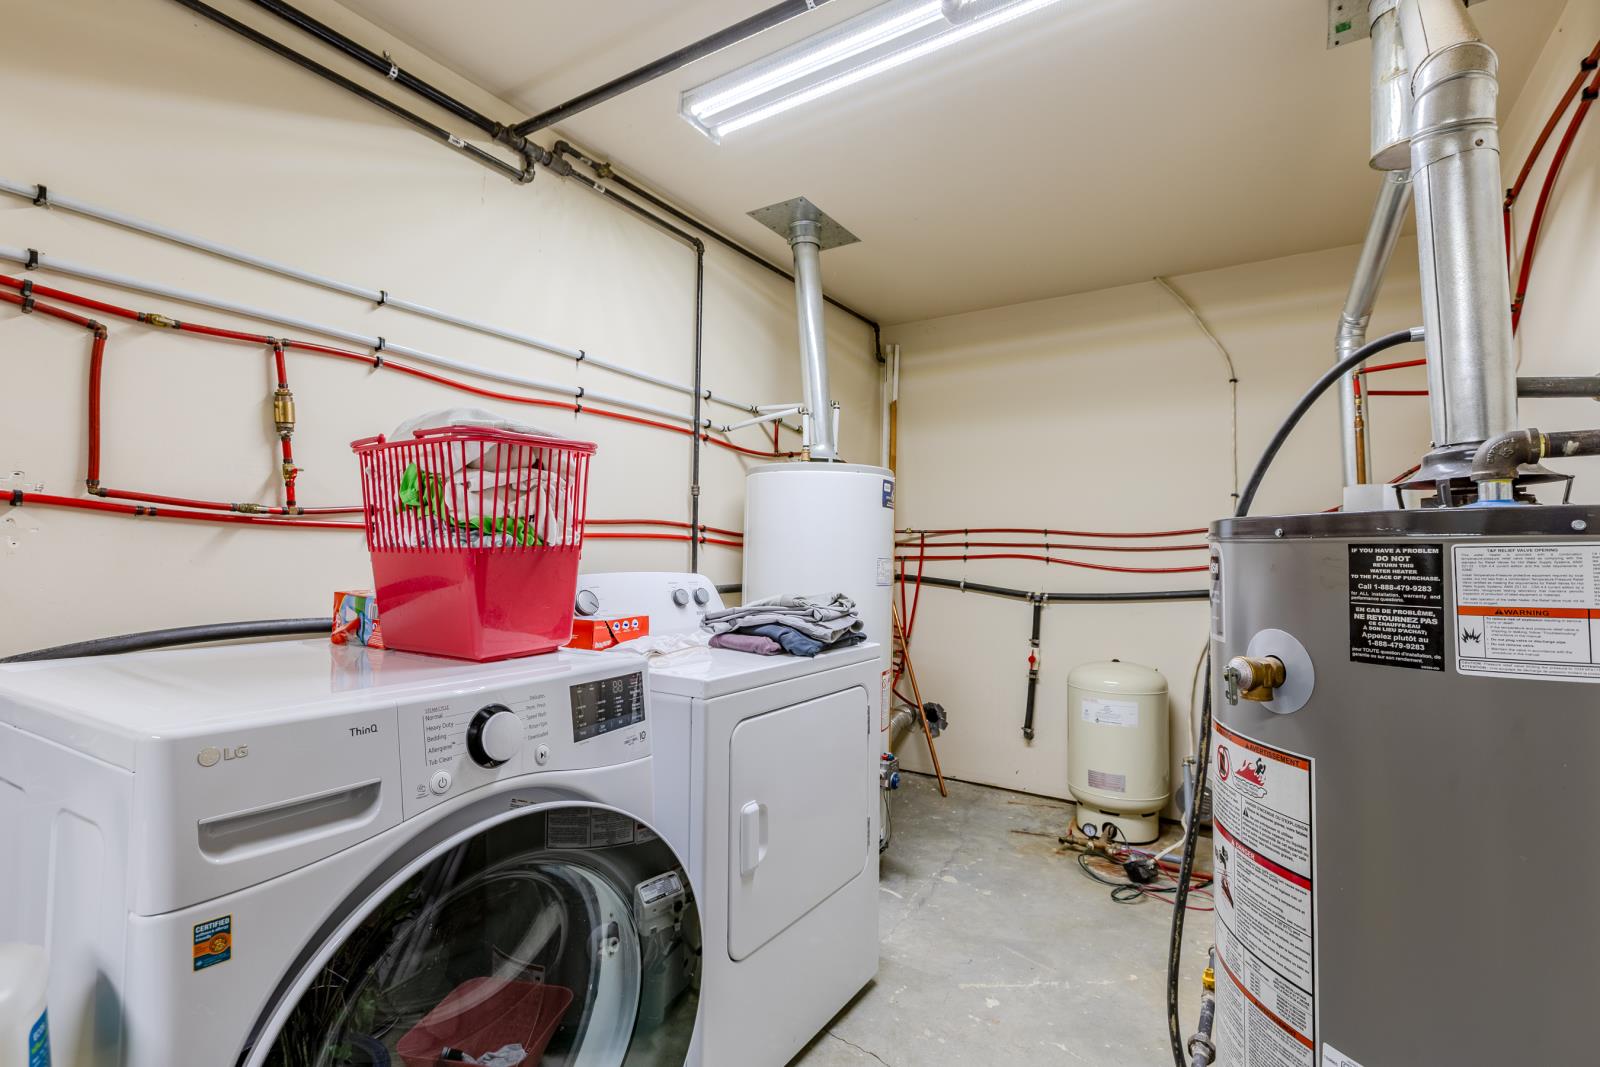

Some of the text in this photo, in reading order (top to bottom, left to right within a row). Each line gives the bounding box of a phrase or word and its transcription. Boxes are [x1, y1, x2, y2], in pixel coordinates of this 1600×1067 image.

[1374, 584, 1432, 592] 1-888-479-9283
[1367, 614, 1418, 624] RETOURNEZ
[1362, 631, 1392, 639] Appelez
[1368, 640, 1425, 650] 1-888-479-9283
[349, 724, 378, 736] ThinQ
[224, 744, 249, 761] LG
[1248, 746, 1300, 767] AVERTISSEMENT
[195, 918, 230, 933] CERTIFIED
